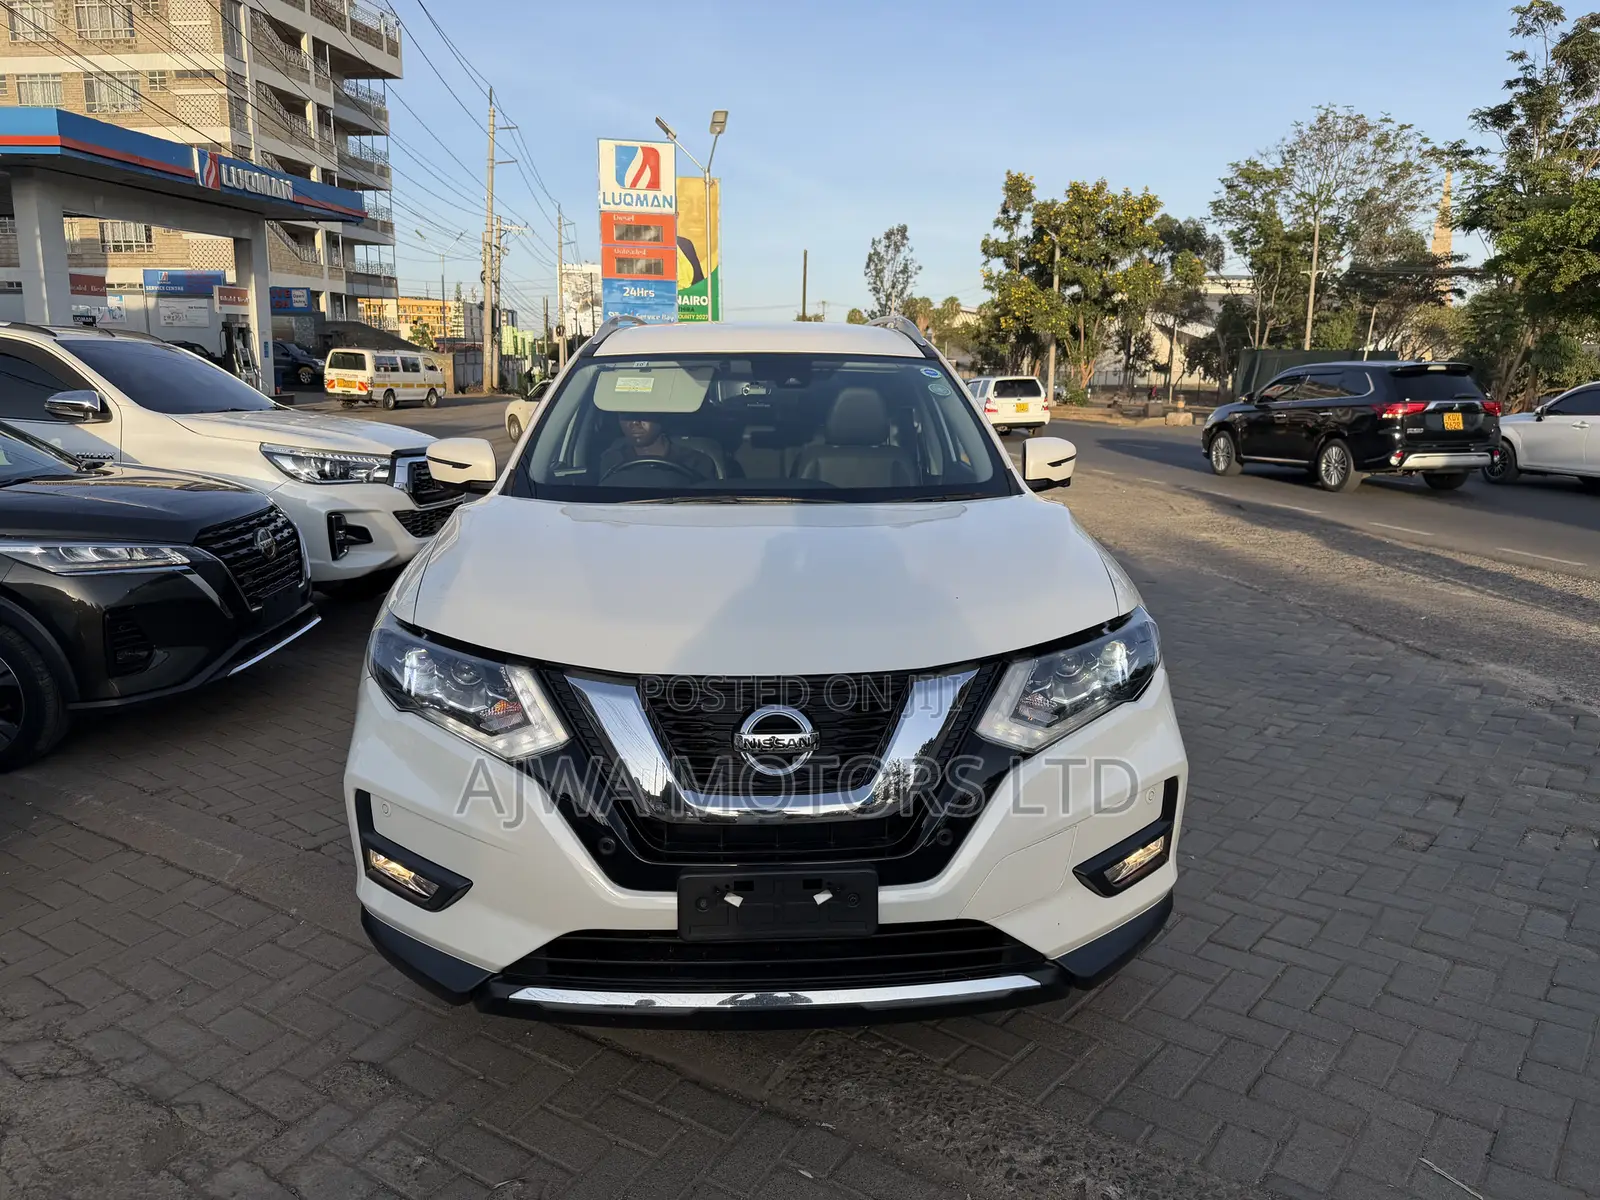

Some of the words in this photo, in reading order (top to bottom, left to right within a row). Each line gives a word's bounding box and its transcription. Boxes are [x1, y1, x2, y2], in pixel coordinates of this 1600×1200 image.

[220, 163, 294, 200] LUQMAN
[602, 191, 673, 208] LUQMAN
[622, 286, 655, 297] 24Hrs
[742, 736, 811, 750] NISSAN
